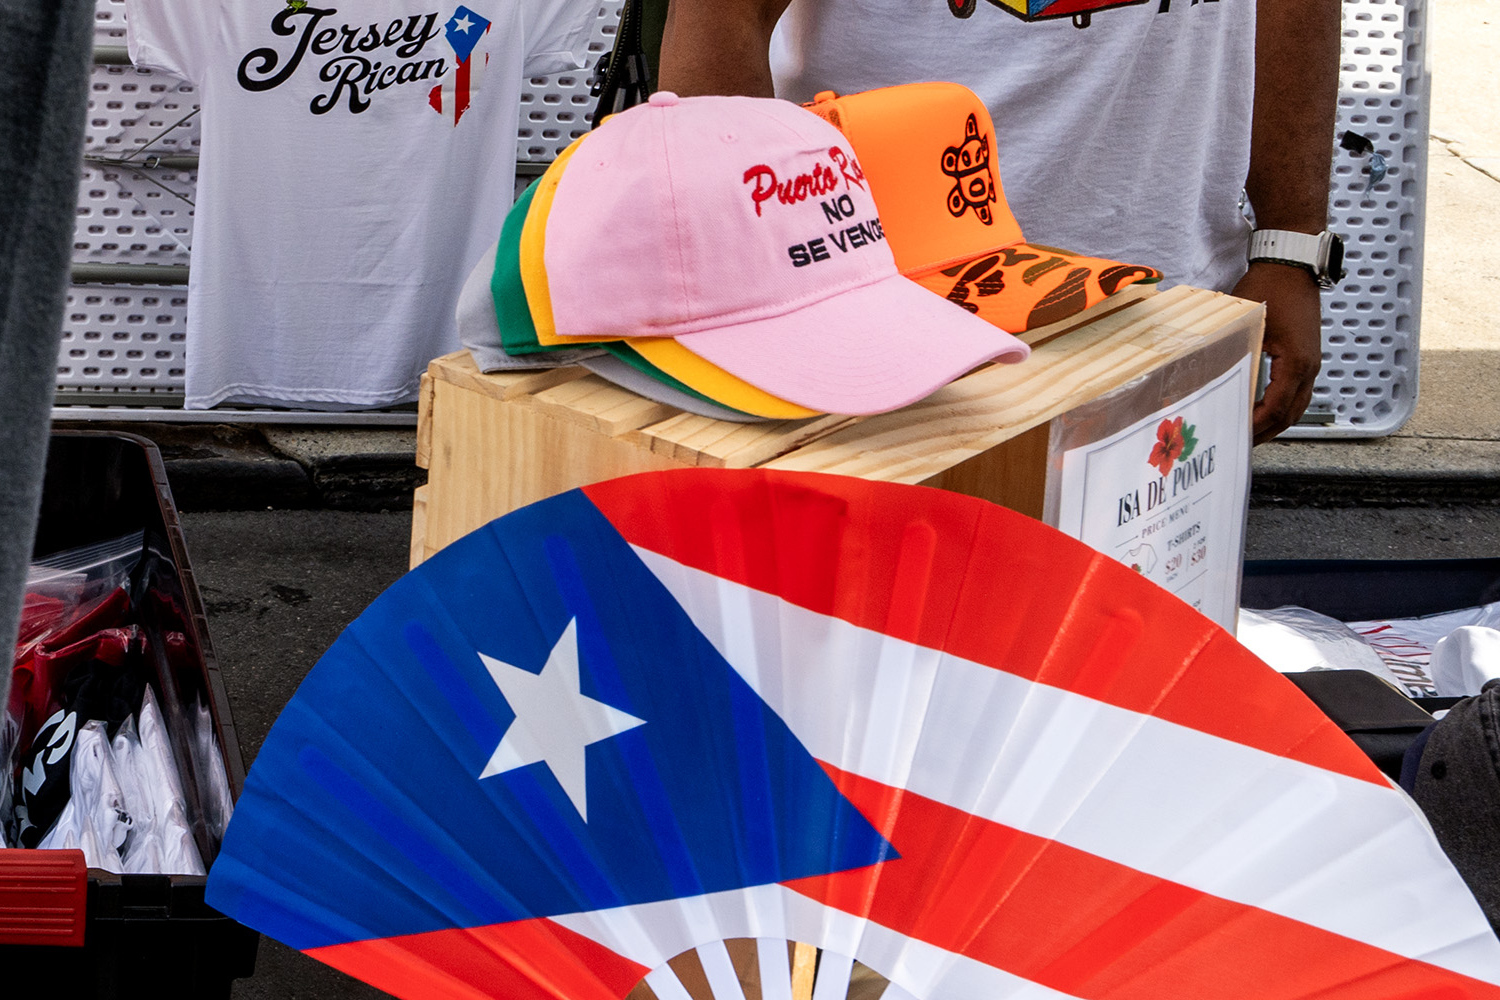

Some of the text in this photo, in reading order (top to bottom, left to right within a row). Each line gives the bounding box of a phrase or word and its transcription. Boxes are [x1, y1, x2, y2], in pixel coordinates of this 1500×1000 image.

[237, 6, 441, 92] Jersey
[310, 55, 448, 115] Rican
[743, 162, 842, 217] Puerto
[820, 194, 855, 225] NO
[788, 238, 832, 268] SE
[1117, 445, 1217, 527] ISA DE PONCE
[1141, 518, 1168, 538] PRICE
